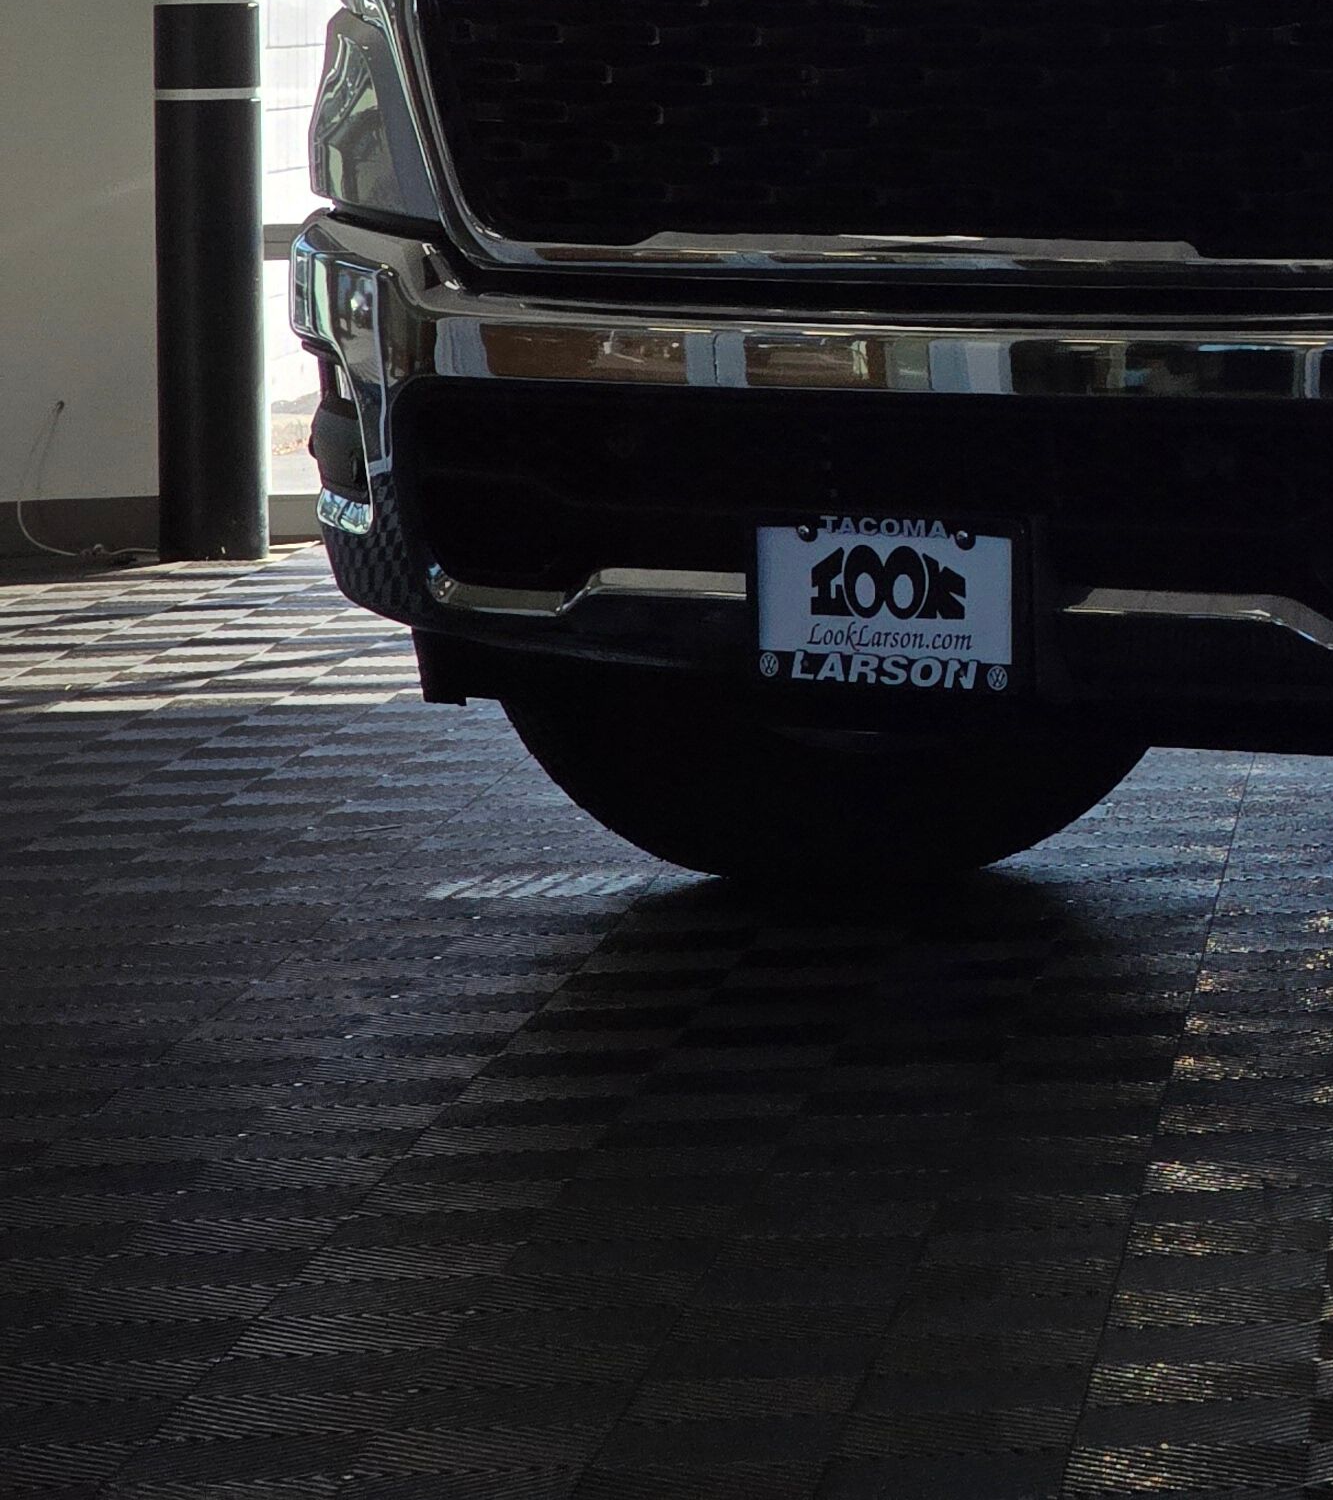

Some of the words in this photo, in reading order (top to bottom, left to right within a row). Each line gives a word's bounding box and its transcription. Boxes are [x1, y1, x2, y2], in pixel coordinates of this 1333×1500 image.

[820, 515, 948, 539] TACOMA
[807, 622, 973, 651] LookLarson.com
[791, 650, 978, 690] LARSON
